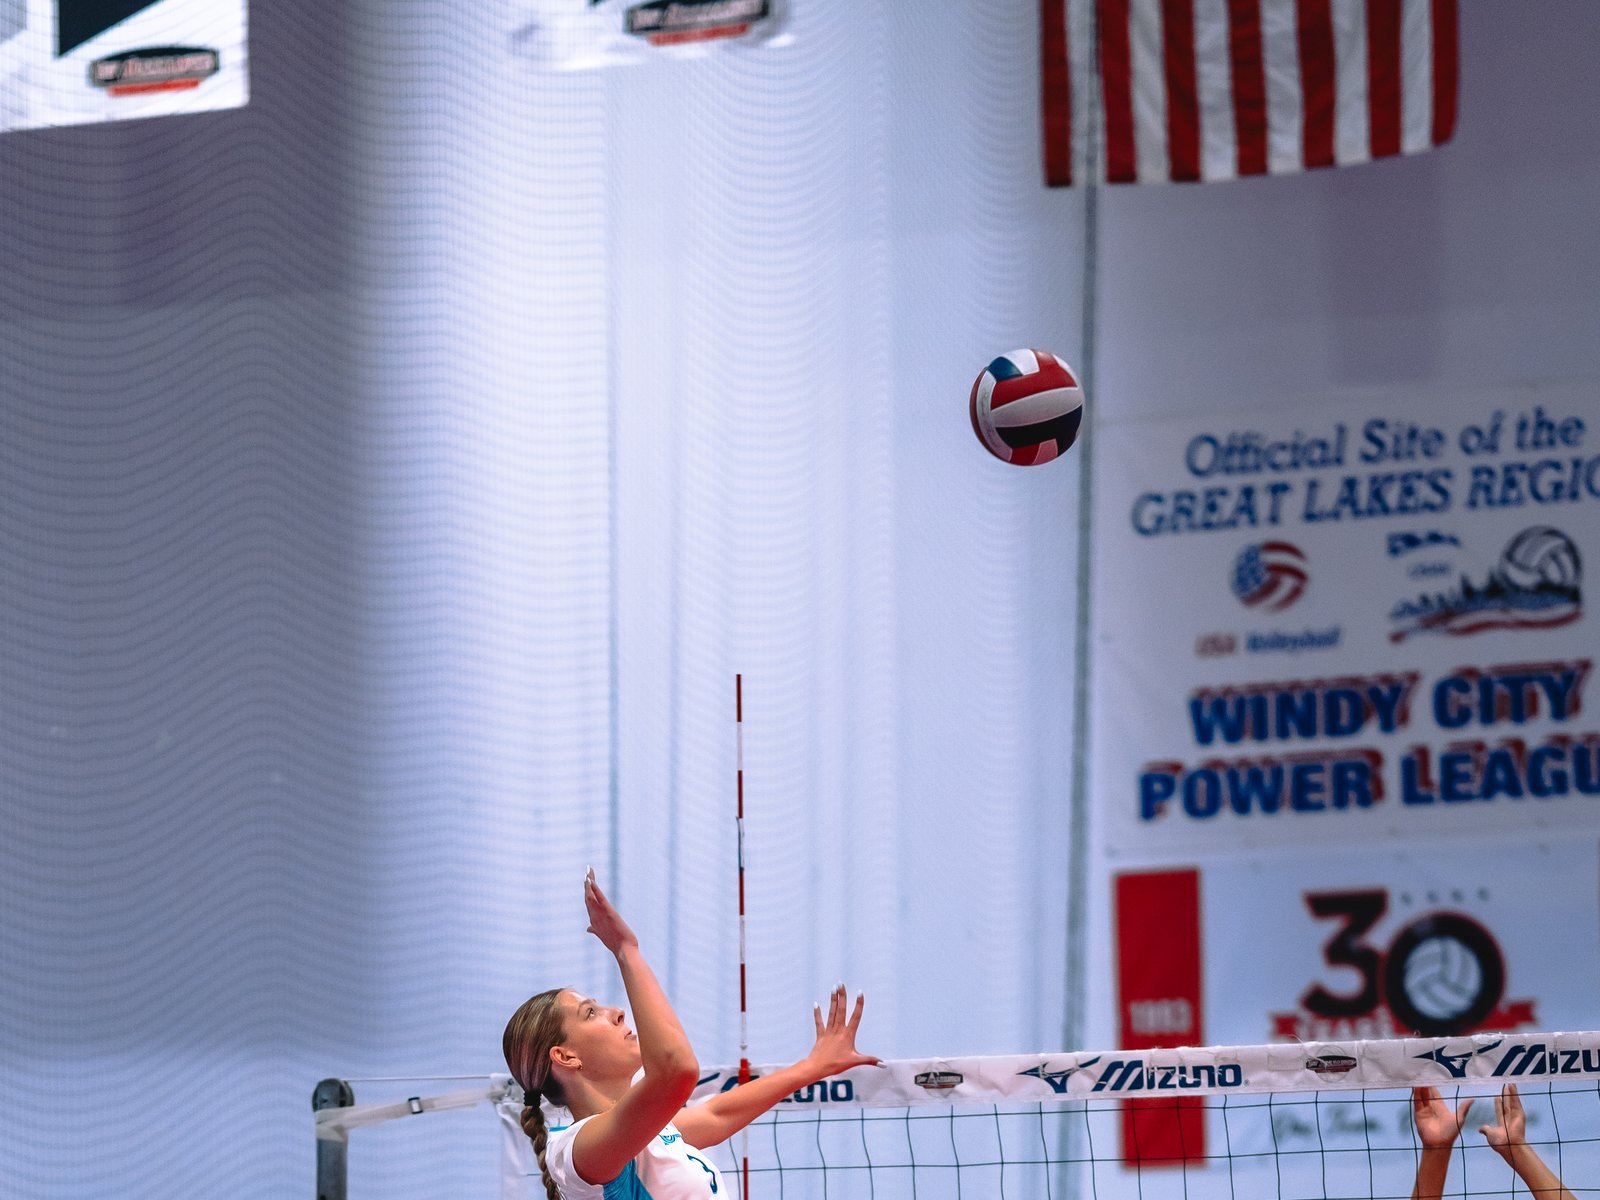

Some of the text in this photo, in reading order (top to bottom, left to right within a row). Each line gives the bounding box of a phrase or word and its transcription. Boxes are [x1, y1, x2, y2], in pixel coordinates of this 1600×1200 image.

[1185, 405, 1586, 477] Official Site of the
[1131, 480, 1291, 537] GREAT
[1303, 468, 1453, 524] LAKES
[1188, 663, 1588, 747] WINDY CITY
[1138, 751, 1381, 821] POWER
